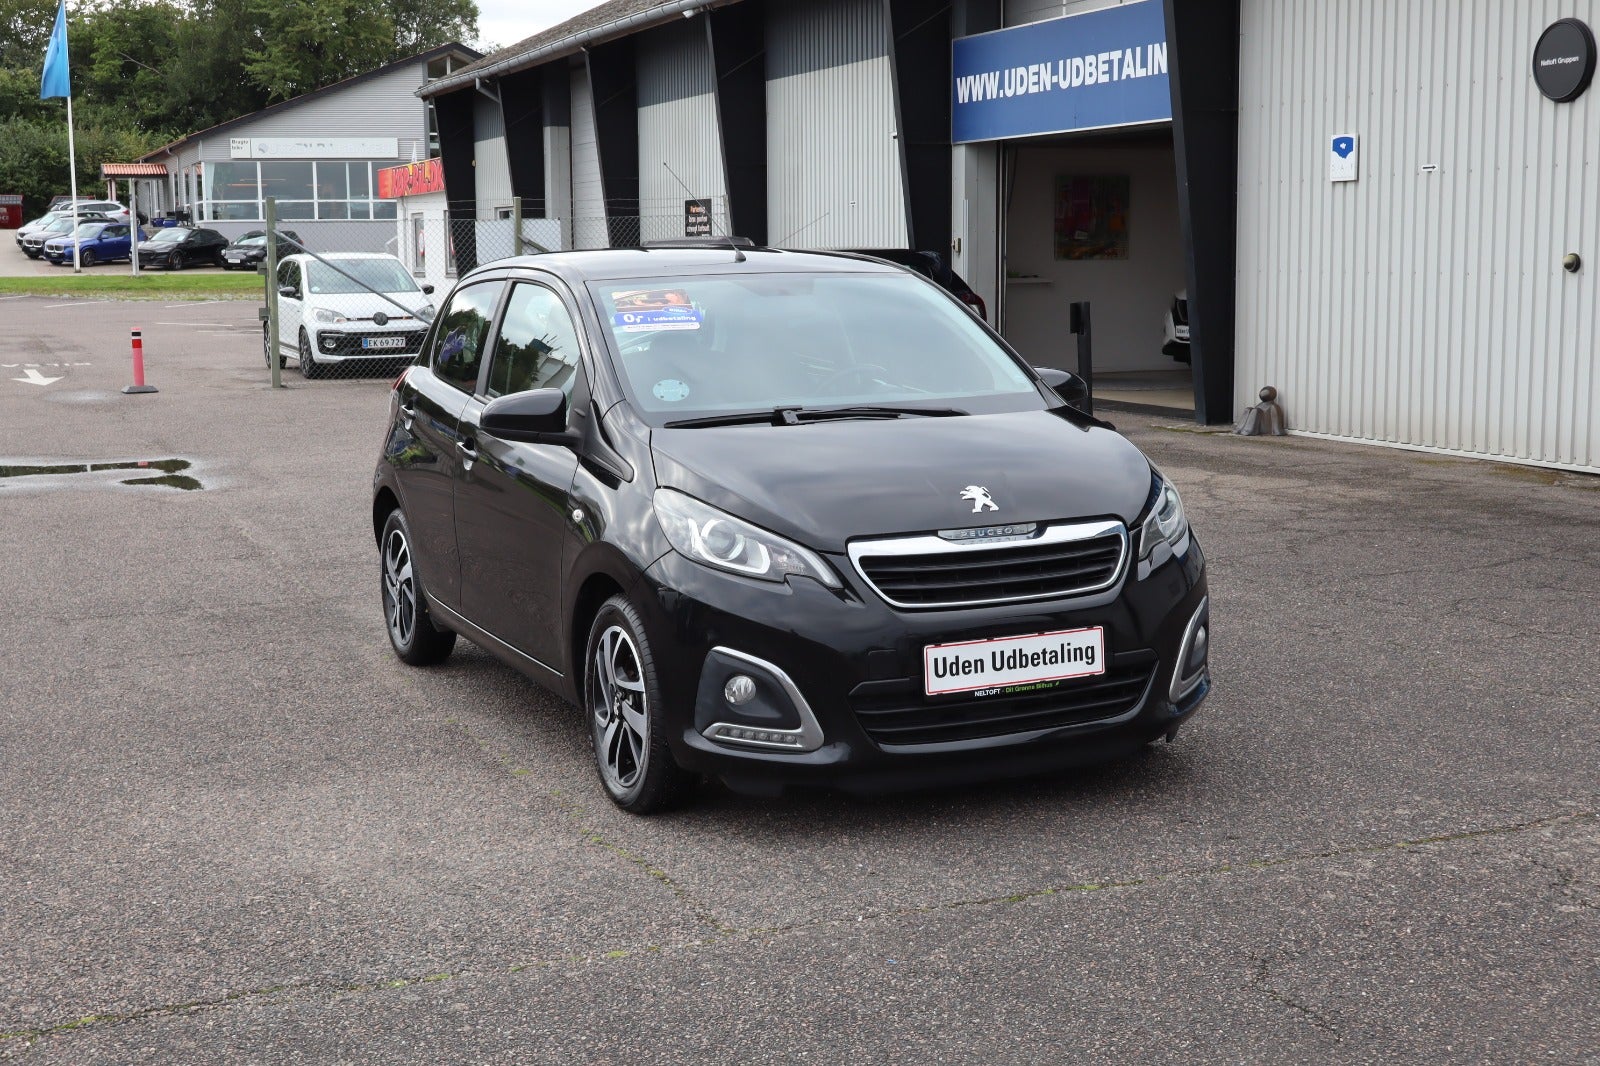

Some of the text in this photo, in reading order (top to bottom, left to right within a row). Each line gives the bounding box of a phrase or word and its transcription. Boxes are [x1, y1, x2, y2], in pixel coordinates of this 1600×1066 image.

[956, 42, 1168, 104] WWW.UDEN-UDBETALIN
[1540, 56, 1579, 67] Neltoft Gruppen
[933, 642, 1096, 679] Uden Udbetaling
[974, 688, 1001, 697] NELTOFT
